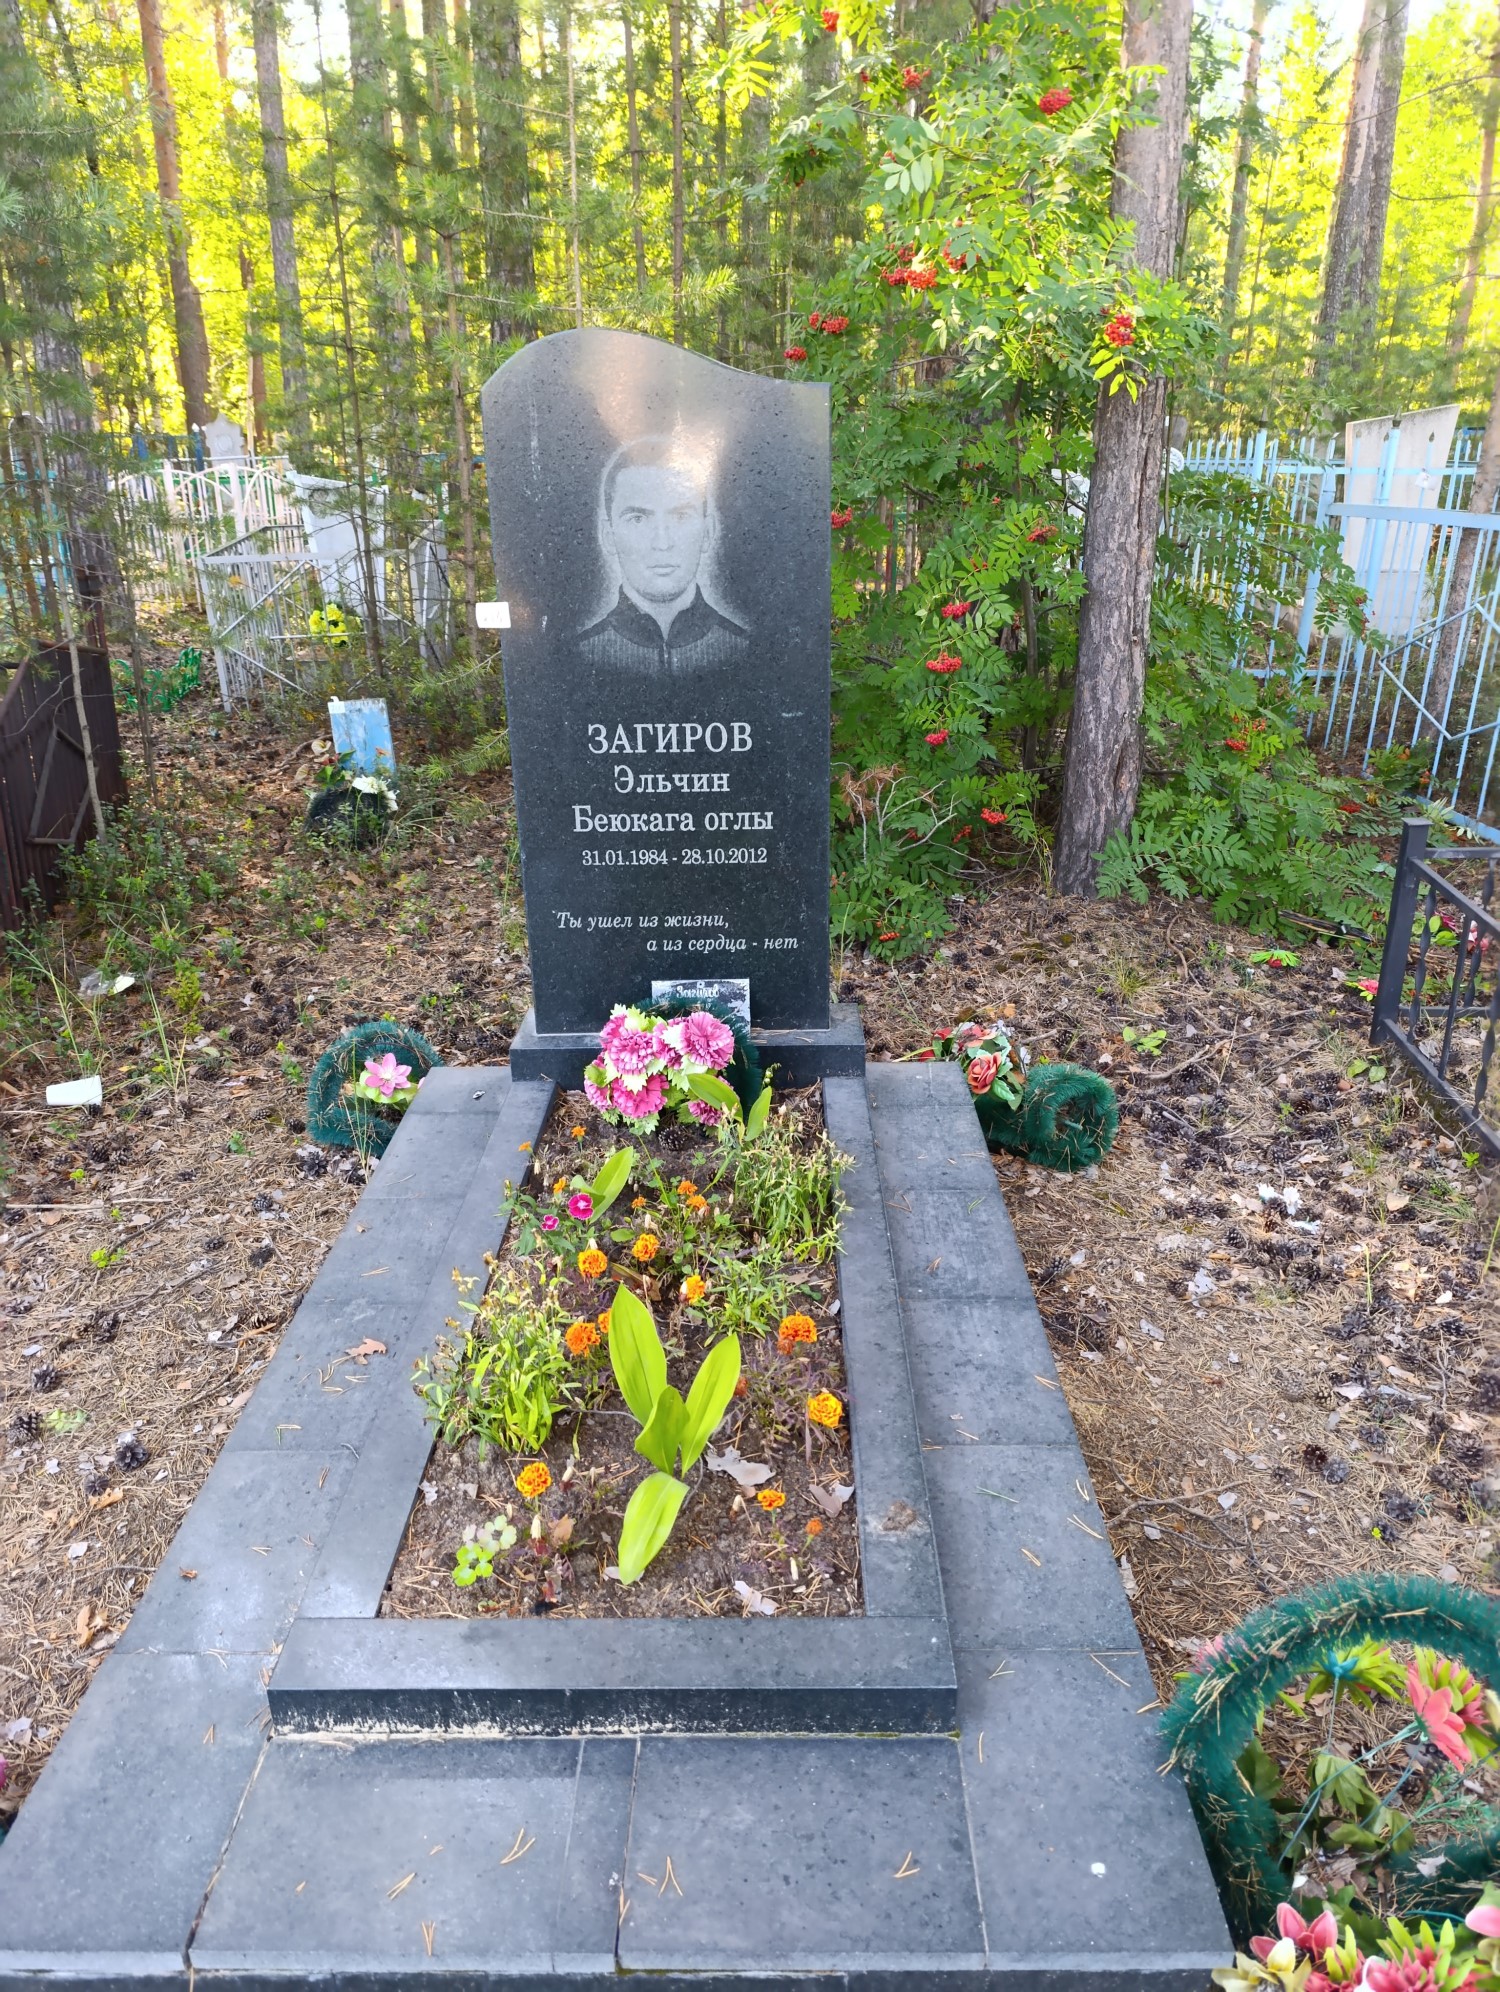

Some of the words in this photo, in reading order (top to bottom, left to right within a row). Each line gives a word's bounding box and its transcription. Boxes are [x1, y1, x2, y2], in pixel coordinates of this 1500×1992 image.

[588, 722, 753, 754] ЗАГИРОВ
[613, 764, 730, 793] Эльчин
[572, 805, 695, 832] Беюкага
[704, 810, 774, 830] оглы
[582, 849, 669, 866] 31.01.1984
[681, 847, 768, 865] 28.10.2012
[556, 911, 583, 929] Ты
[587, 914, 633, 932] ушел
[638, 914, 658, 928] из
[664, 912, 730, 930] жизни,
[646, 938, 657, 951] а
[663, 937, 683, 951] из
[688, 934, 747, 954] сердца
[763, 935, 799, 949] нет
